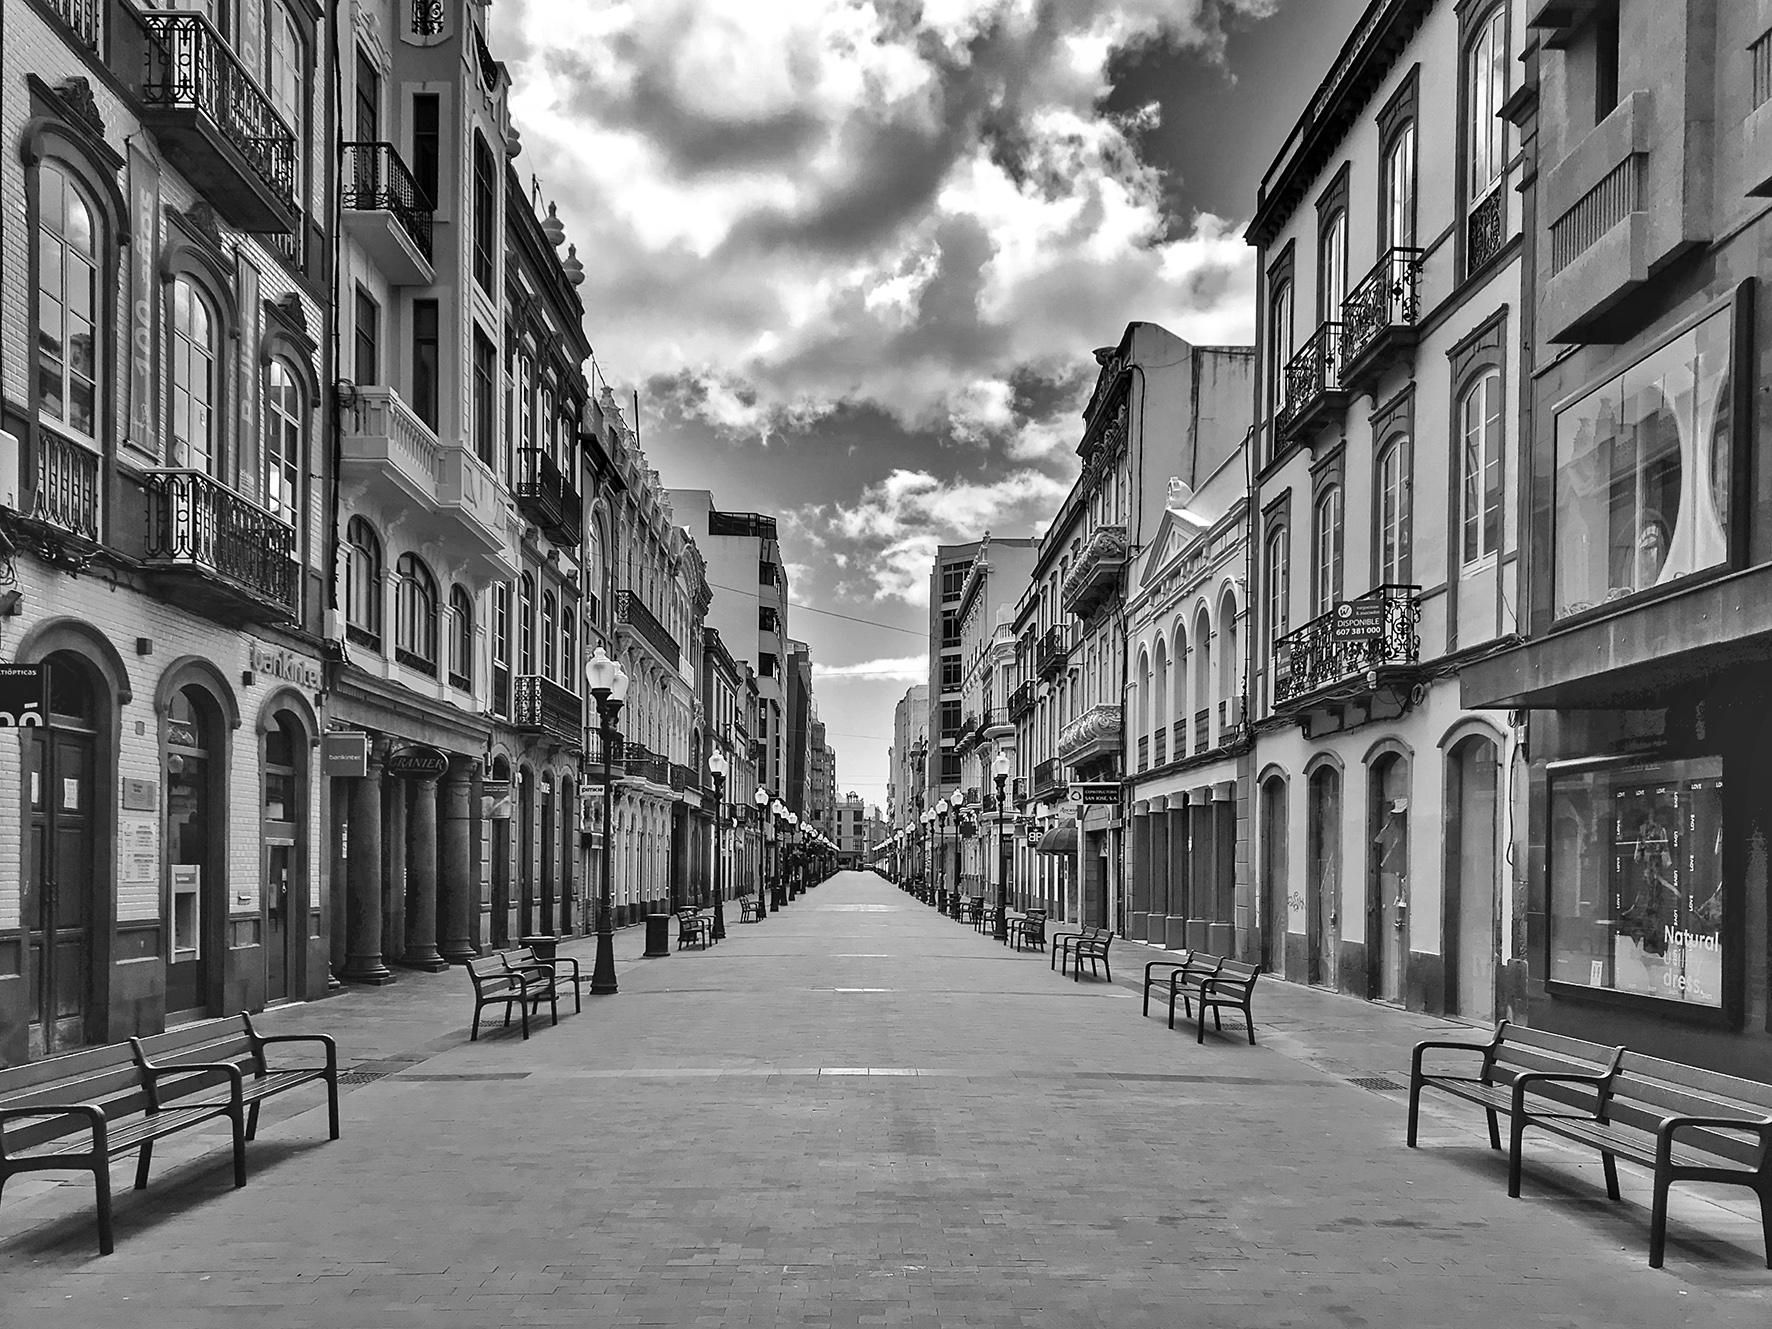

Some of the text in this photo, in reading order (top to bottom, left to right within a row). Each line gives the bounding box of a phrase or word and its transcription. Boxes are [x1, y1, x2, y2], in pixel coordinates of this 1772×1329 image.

[135, 300, 151, 377] 100
[1337, 618, 1380, 627] DISPONIBLE
[1664, 925, 1719, 952] Natural
